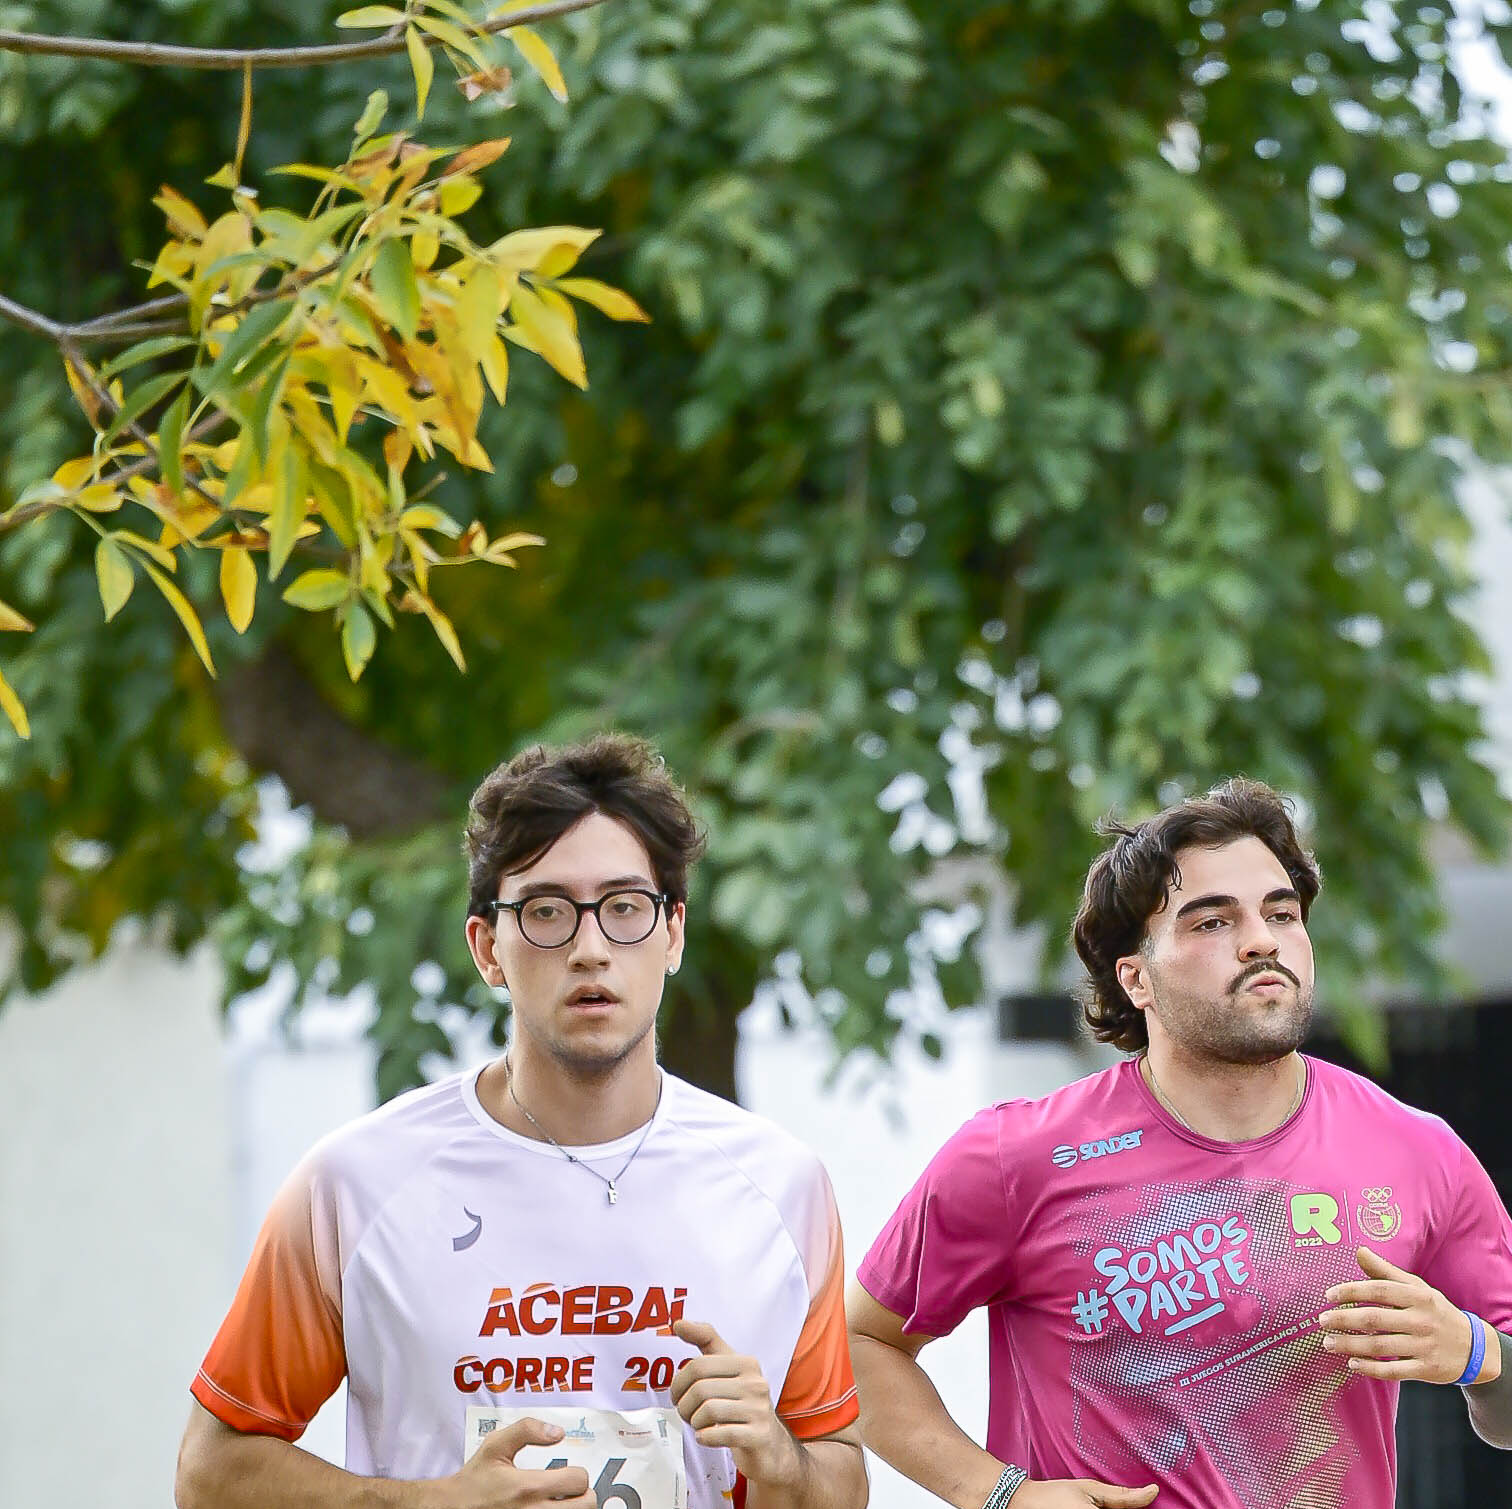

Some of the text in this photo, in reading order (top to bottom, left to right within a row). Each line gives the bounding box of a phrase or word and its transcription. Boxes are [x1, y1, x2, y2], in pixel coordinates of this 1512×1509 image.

[1094, 1216, 1248, 1295] SOMOS
[1295, 1238, 1323, 1247] 2022
[1071, 1250, 1249, 1334] #PARTE
[453, 1355, 694, 1393] CORRE 20
[1191, 1362, 1225, 1383] JUEGOS
